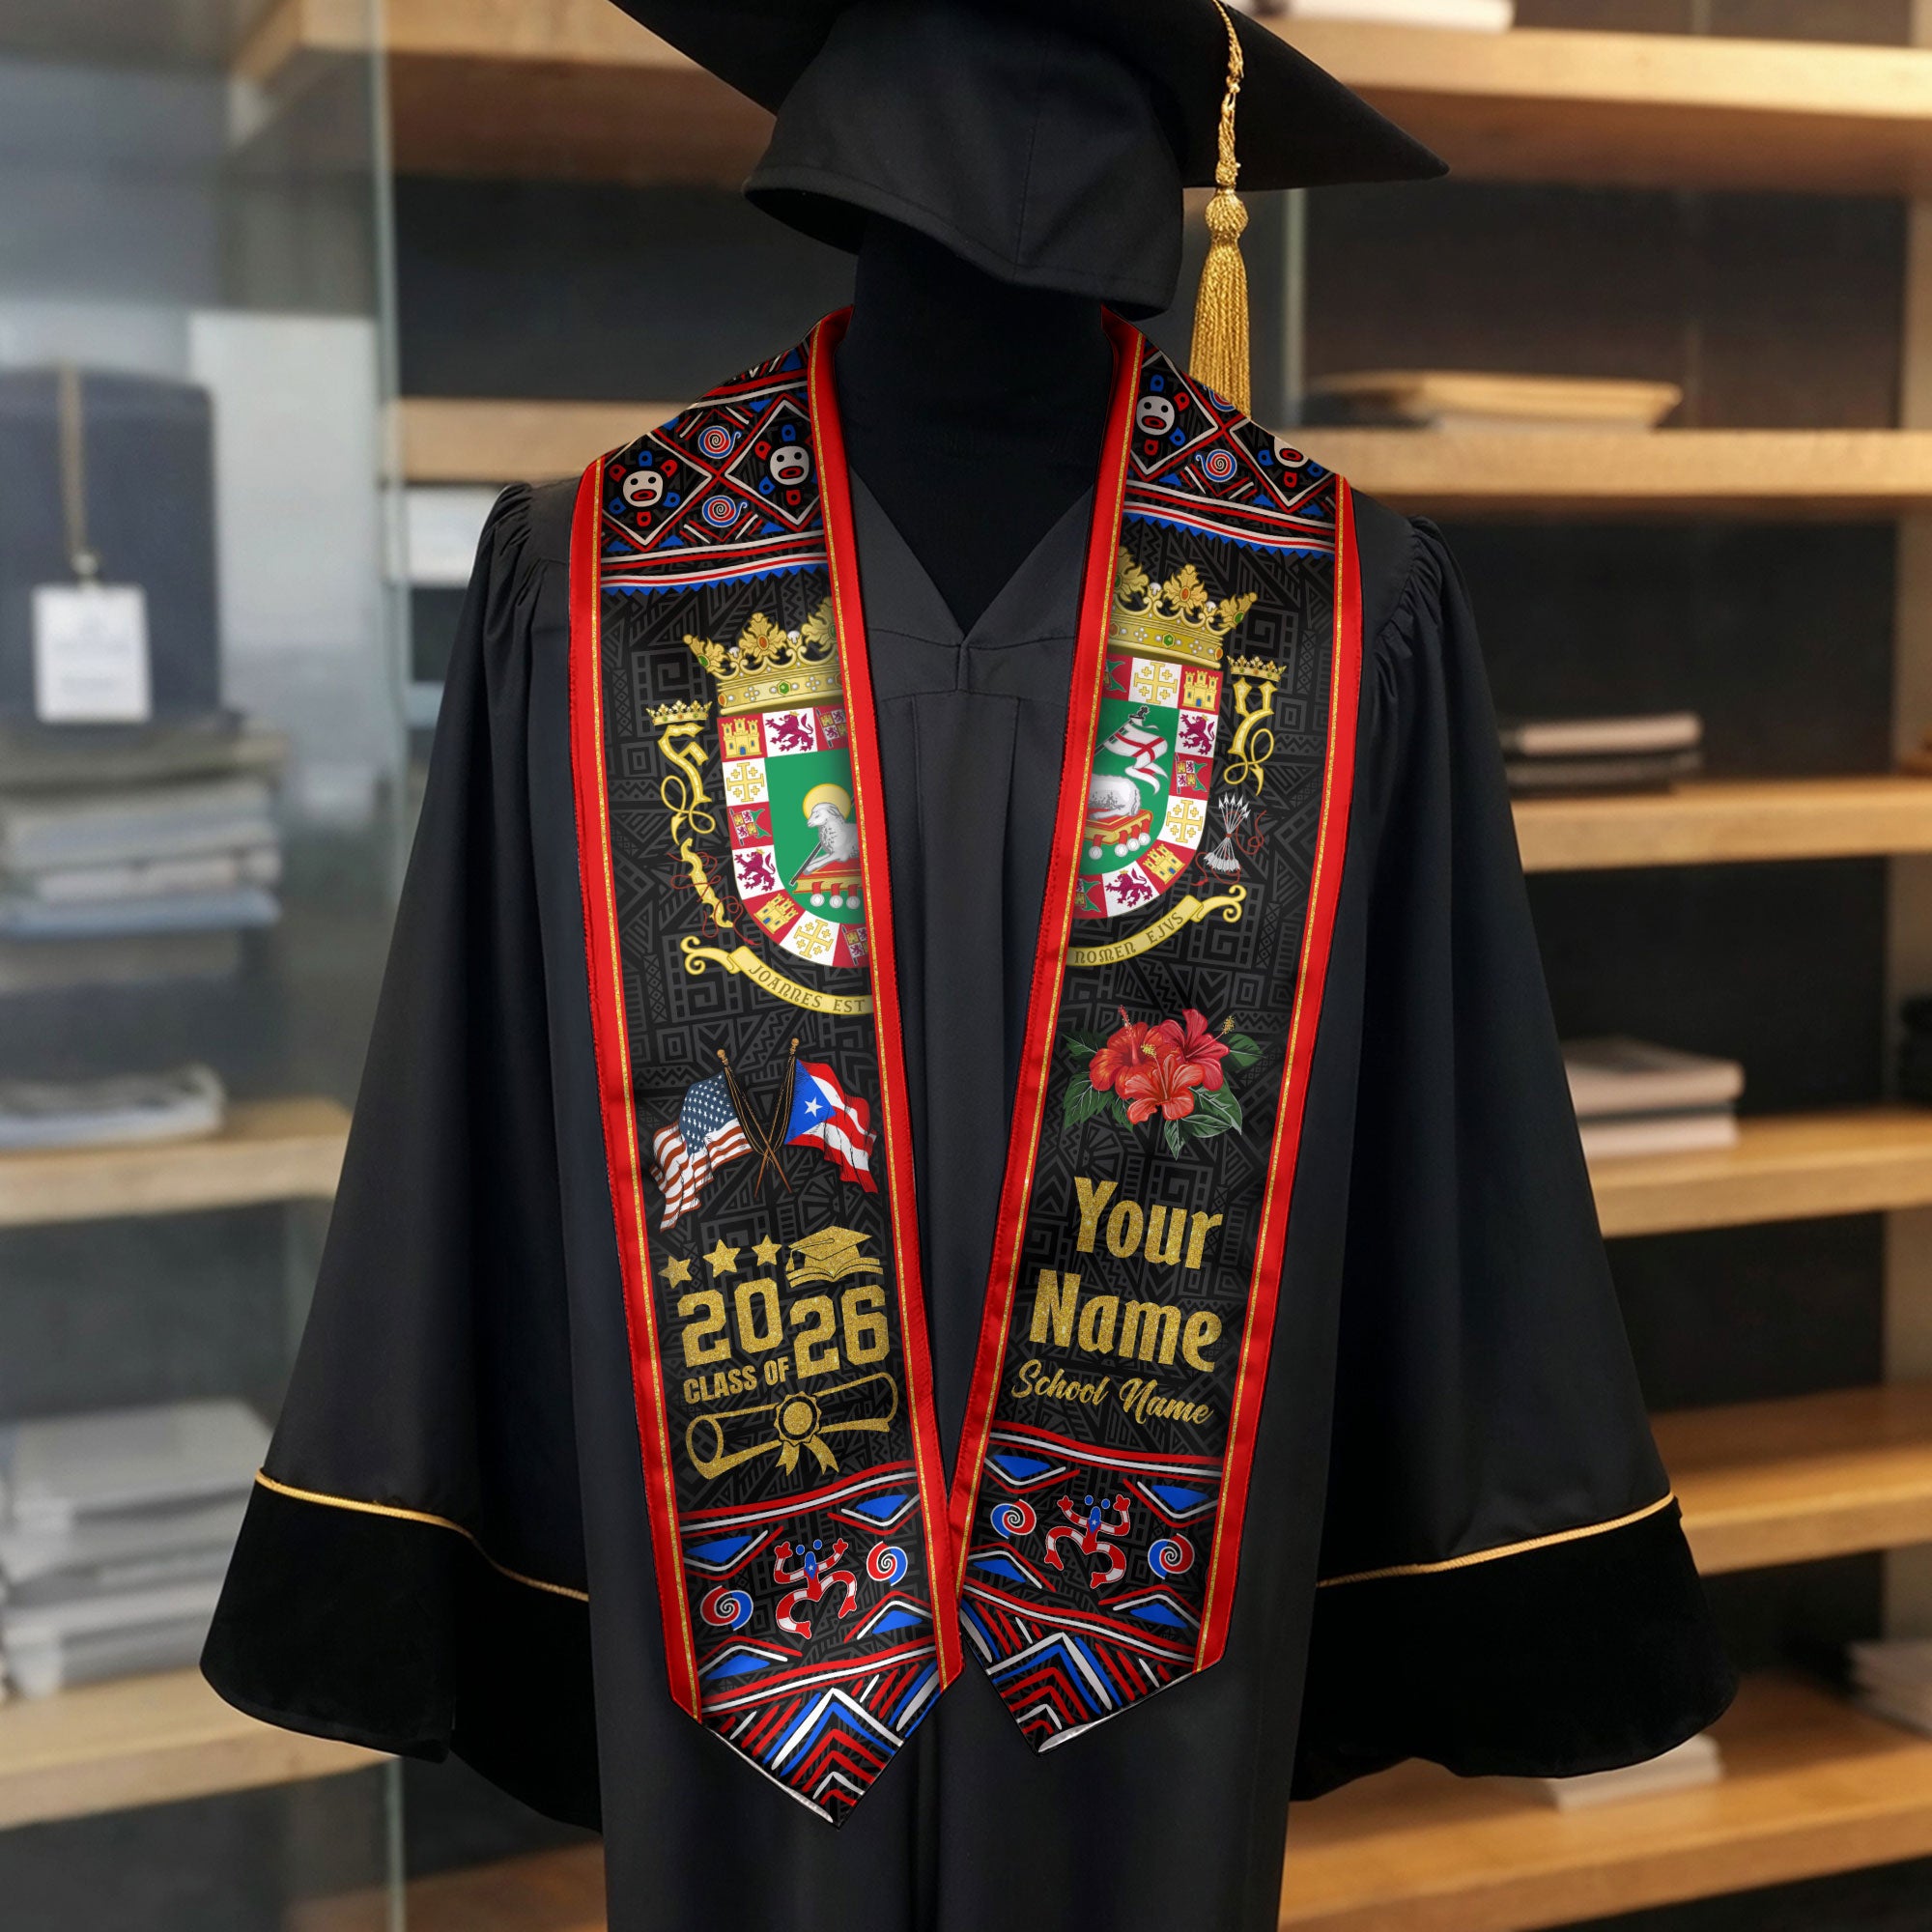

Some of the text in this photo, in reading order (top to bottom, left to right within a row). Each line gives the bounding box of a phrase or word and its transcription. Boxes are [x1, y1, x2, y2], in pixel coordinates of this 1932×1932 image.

[1074, 941, 1136, 964] NOMEN
[749, 965, 866, 1012] JOANNES EST
[1074, 1176, 1224, 1270] Your
[677, 1277, 891, 1379] 2026
[1029, 1268, 1223, 1373] Name
[683, 1356, 790, 1405] CLASS OF
[1011, 1358, 1214, 1425] School Name
